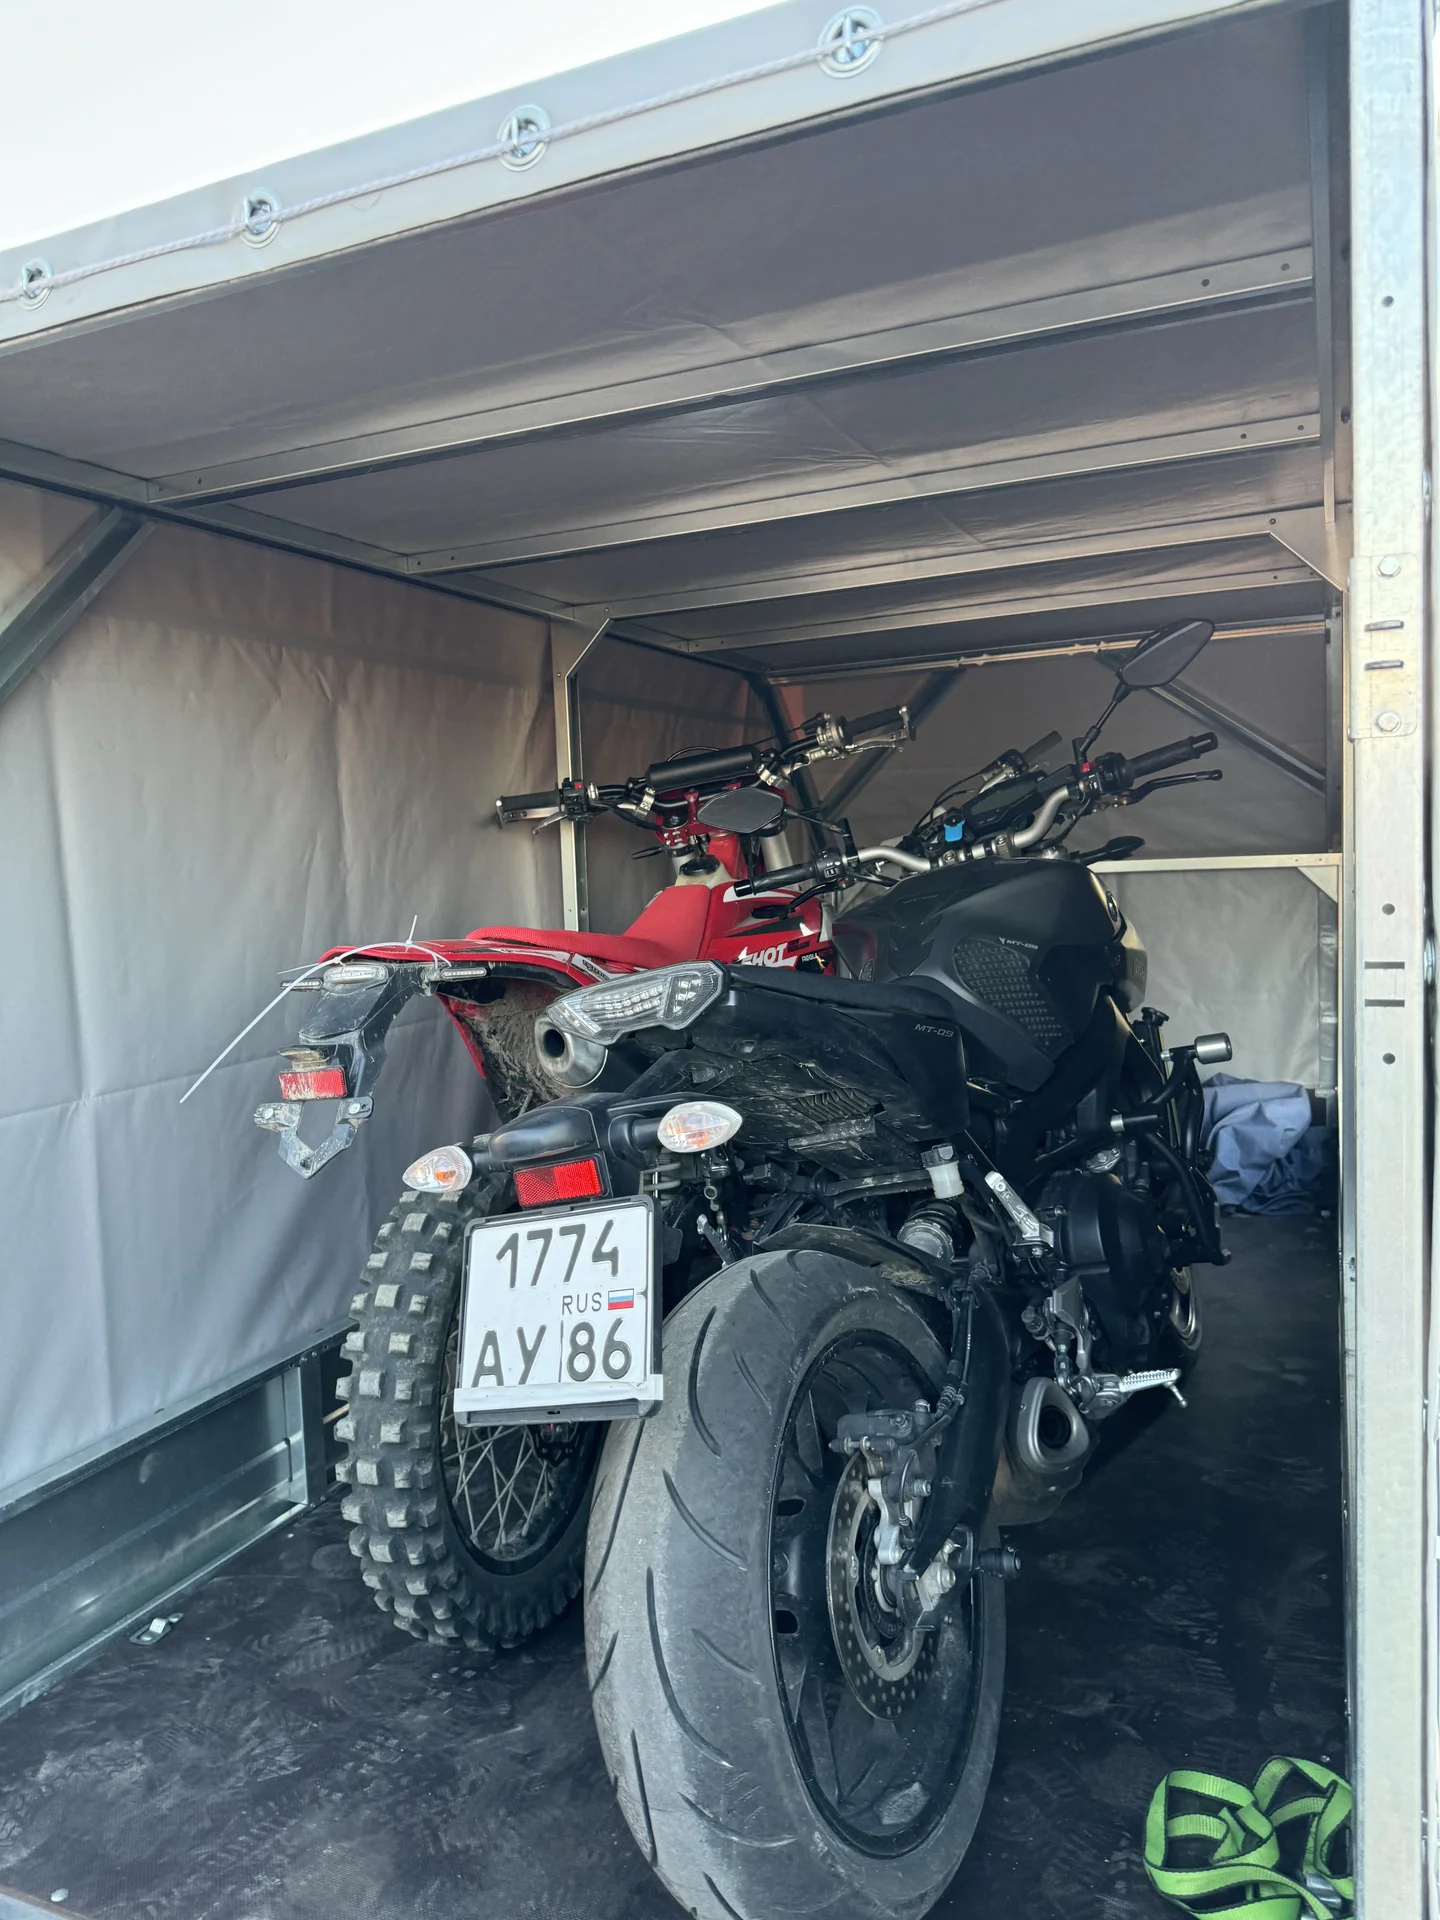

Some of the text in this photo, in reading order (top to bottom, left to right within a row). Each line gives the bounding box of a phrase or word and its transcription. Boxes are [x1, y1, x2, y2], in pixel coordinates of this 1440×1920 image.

[914, 1023, 955, 1038] MT-09
[496, 1219, 619, 1289] 1774
[561, 1292, 602, 1316] RUS
[566, 1317, 632, 1382] 86
